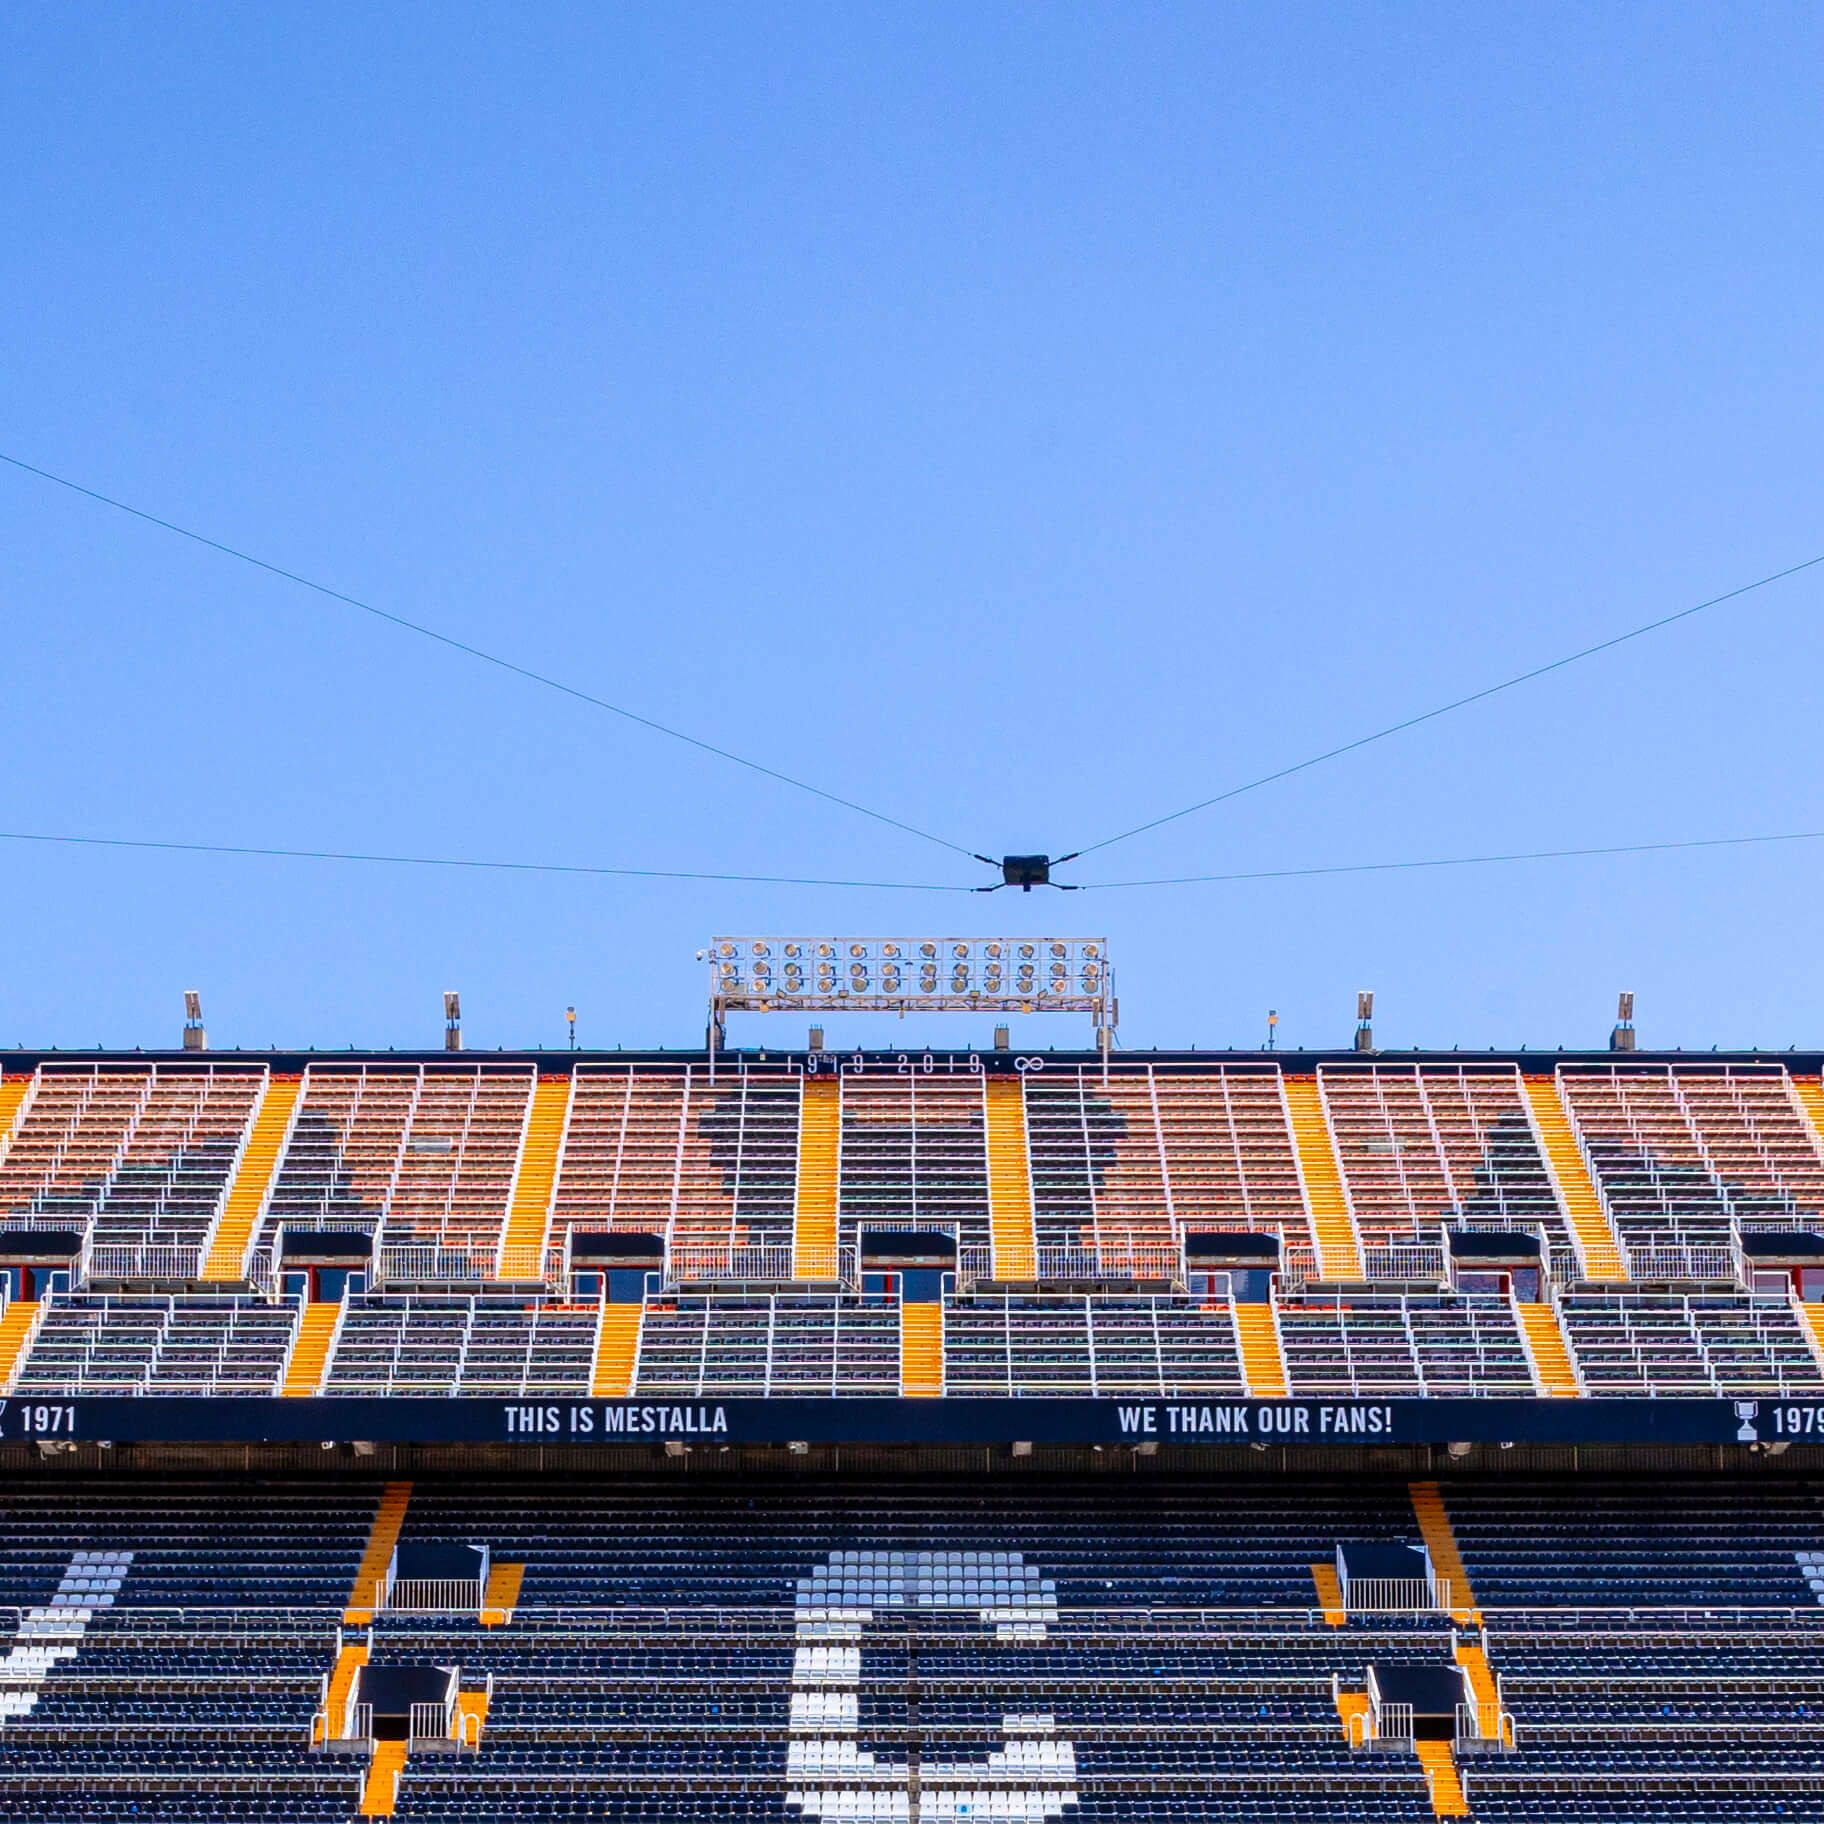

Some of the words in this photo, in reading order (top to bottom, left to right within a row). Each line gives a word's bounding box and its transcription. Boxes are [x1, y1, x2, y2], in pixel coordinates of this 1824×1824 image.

[21, 1406, 75, 1432] 1971
[505, 1406, 560, 1432] THIS
[571, 1406, 594, 1432] IS
[606, 1406, 728, 1432] MESTALLA
[1118, 1406, 1157, 1433] WE
[1166, 1406, 1249, 1433] THANK
[1258, 1406, 1310, 1433] OUR
[1320, 1406, 1393, 1433] FANS!
